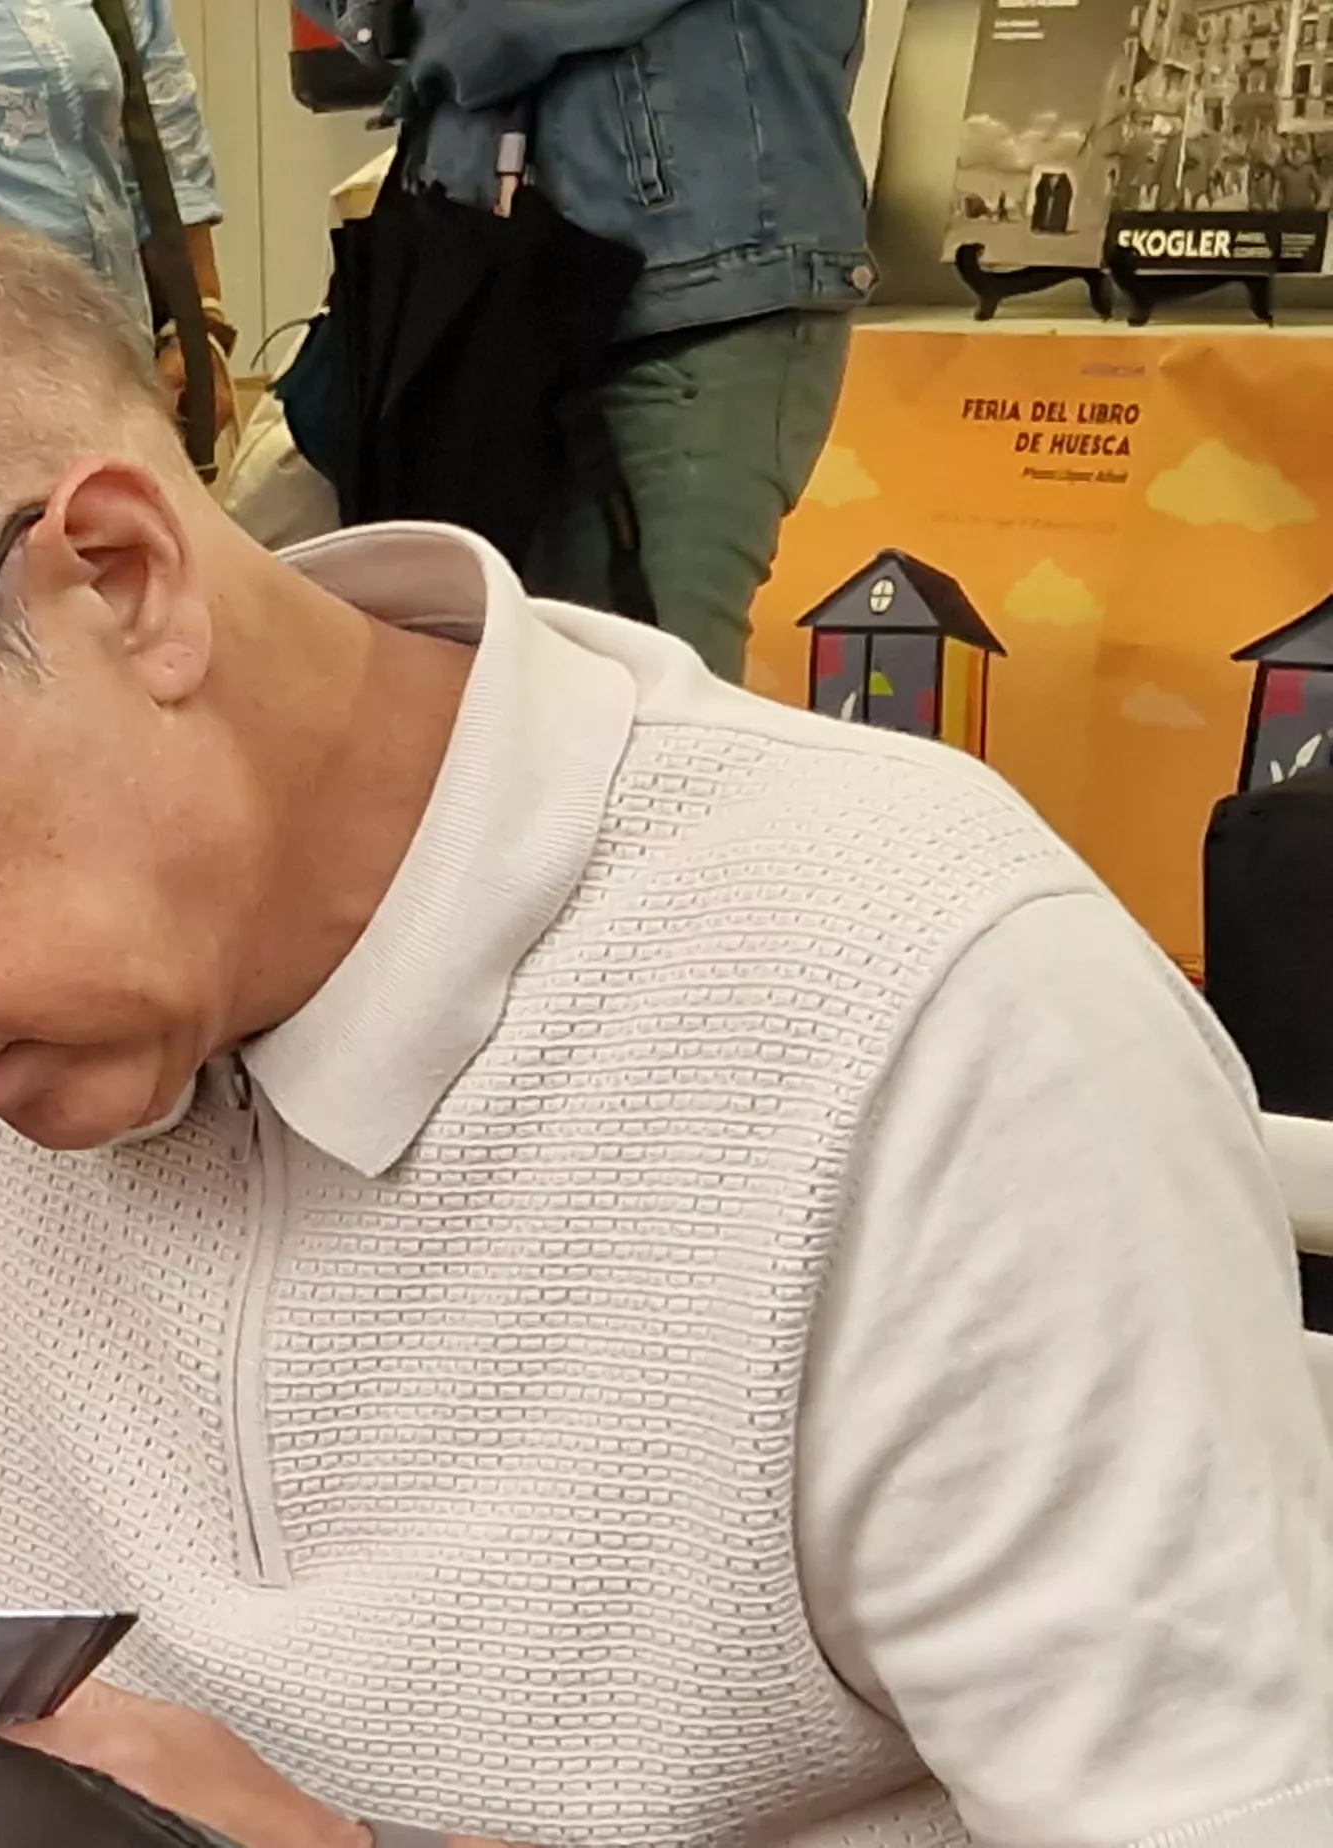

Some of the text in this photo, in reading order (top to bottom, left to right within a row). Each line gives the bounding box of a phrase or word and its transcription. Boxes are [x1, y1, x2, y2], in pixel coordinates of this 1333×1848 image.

[961, 398, 1141, 425] FERIA DEL LIBRO
[1014, 431, 1131, 457] DE HUESCA
